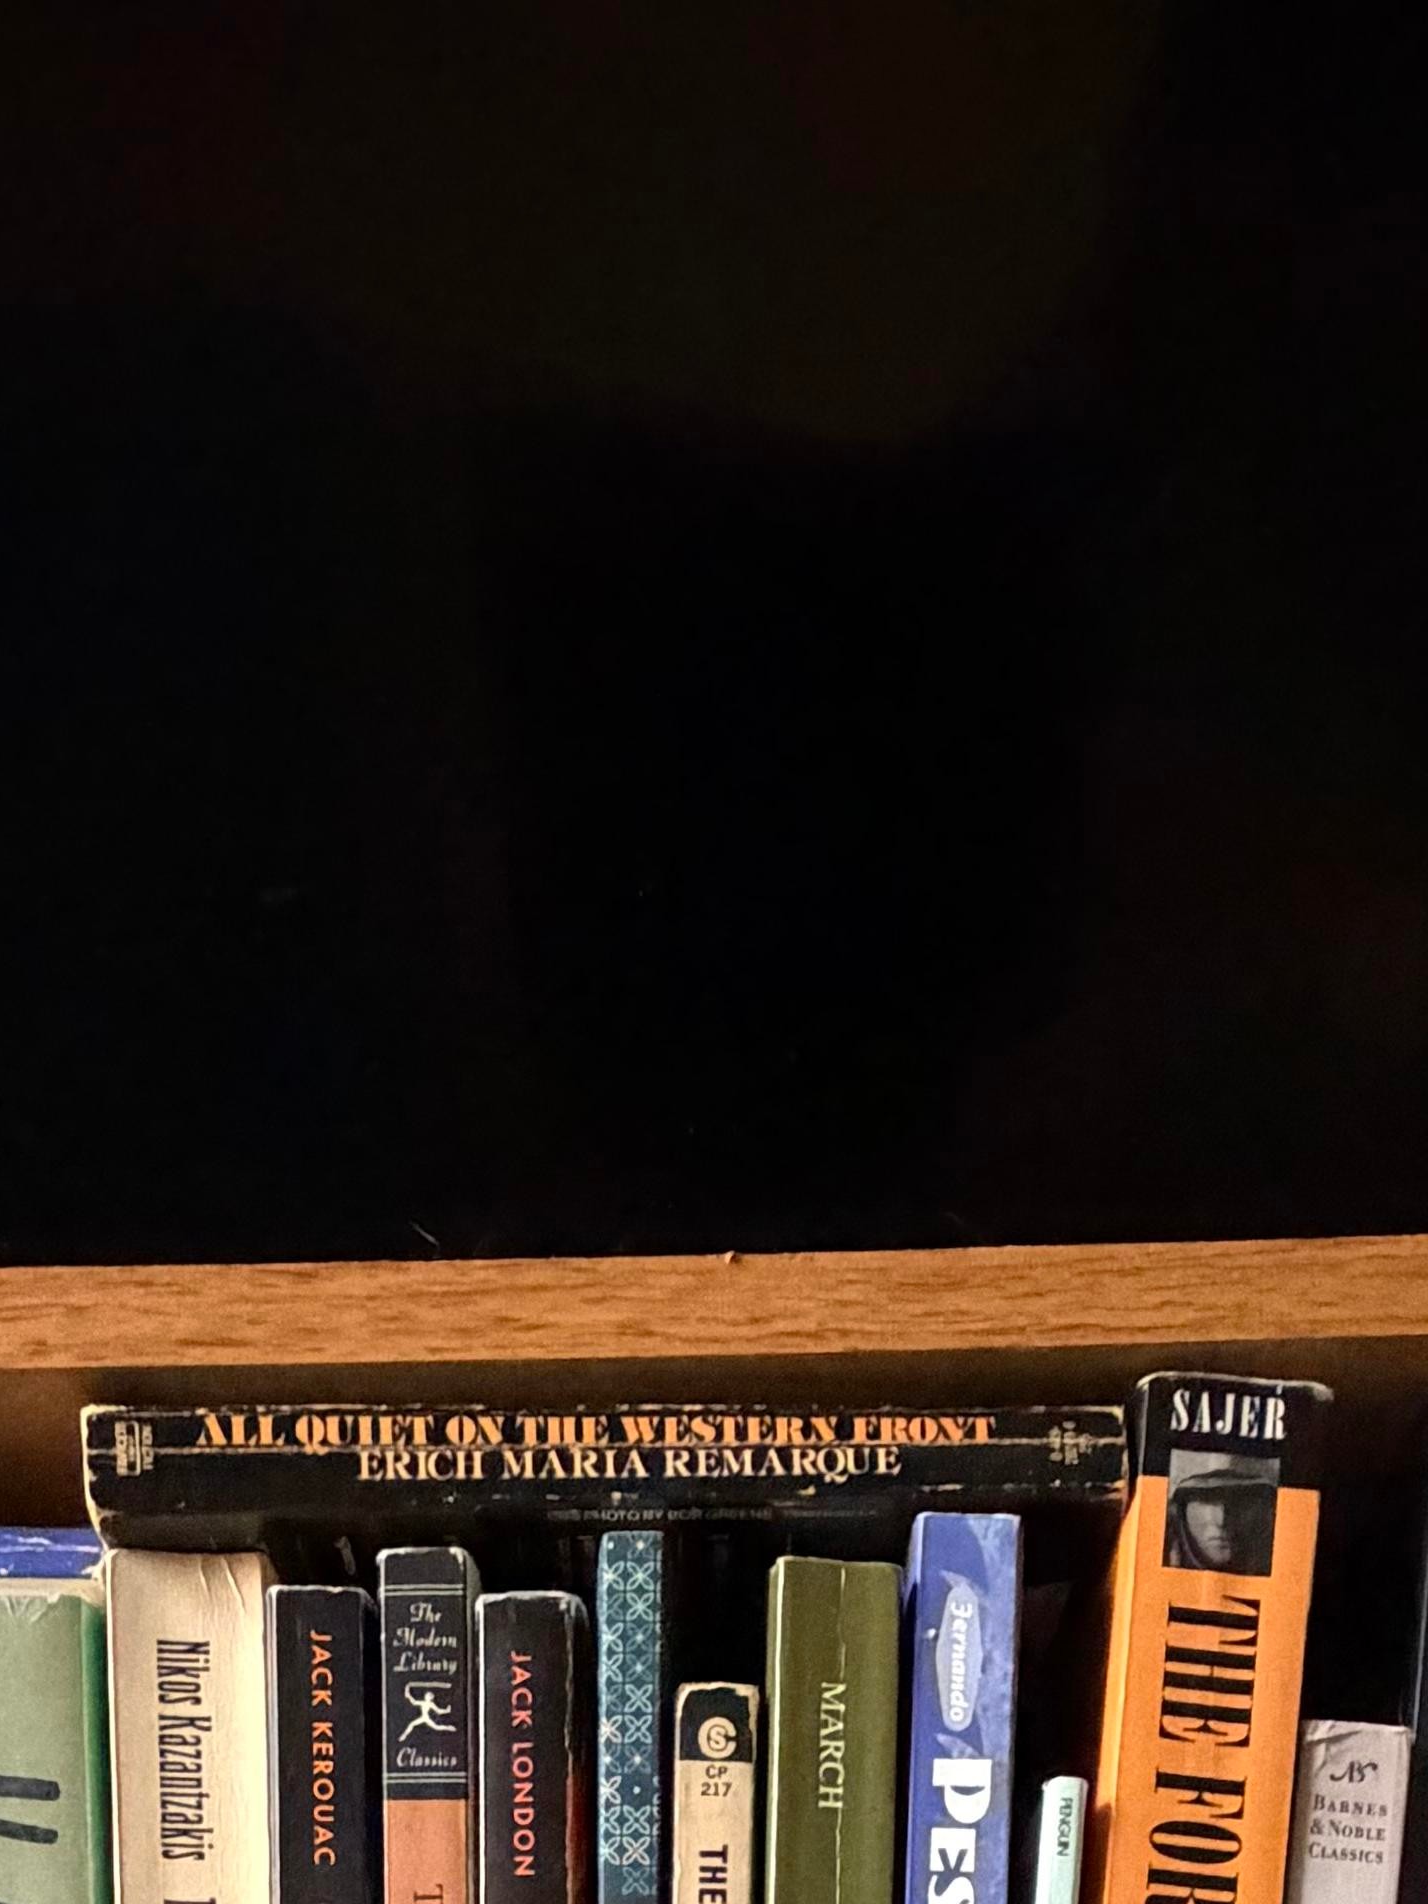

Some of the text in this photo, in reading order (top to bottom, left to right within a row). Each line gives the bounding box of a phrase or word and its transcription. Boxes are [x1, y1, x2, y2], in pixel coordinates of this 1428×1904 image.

[195, 1412, 998, 1448] ALL QUIET ON THE WESTERN FRONT
[1171, 1388, 1287, 1442] SAJER
[357, 1445, 903, 1482] ERICH MARIA REMARQUE
[1158, 1594, 1261, 1748] THE
[156, 1639, 213, 1862] Nikos Kazantzakis
[310, 1630, 335, 1866] JACK KEROUAC
[510, 1651, 535, 1878] JACK LONDON
[700, 1765, 731, 1797] CP 217
[819, 1682, 847, 1809] MARCH
[698, 1846, 729, 1904] THE
